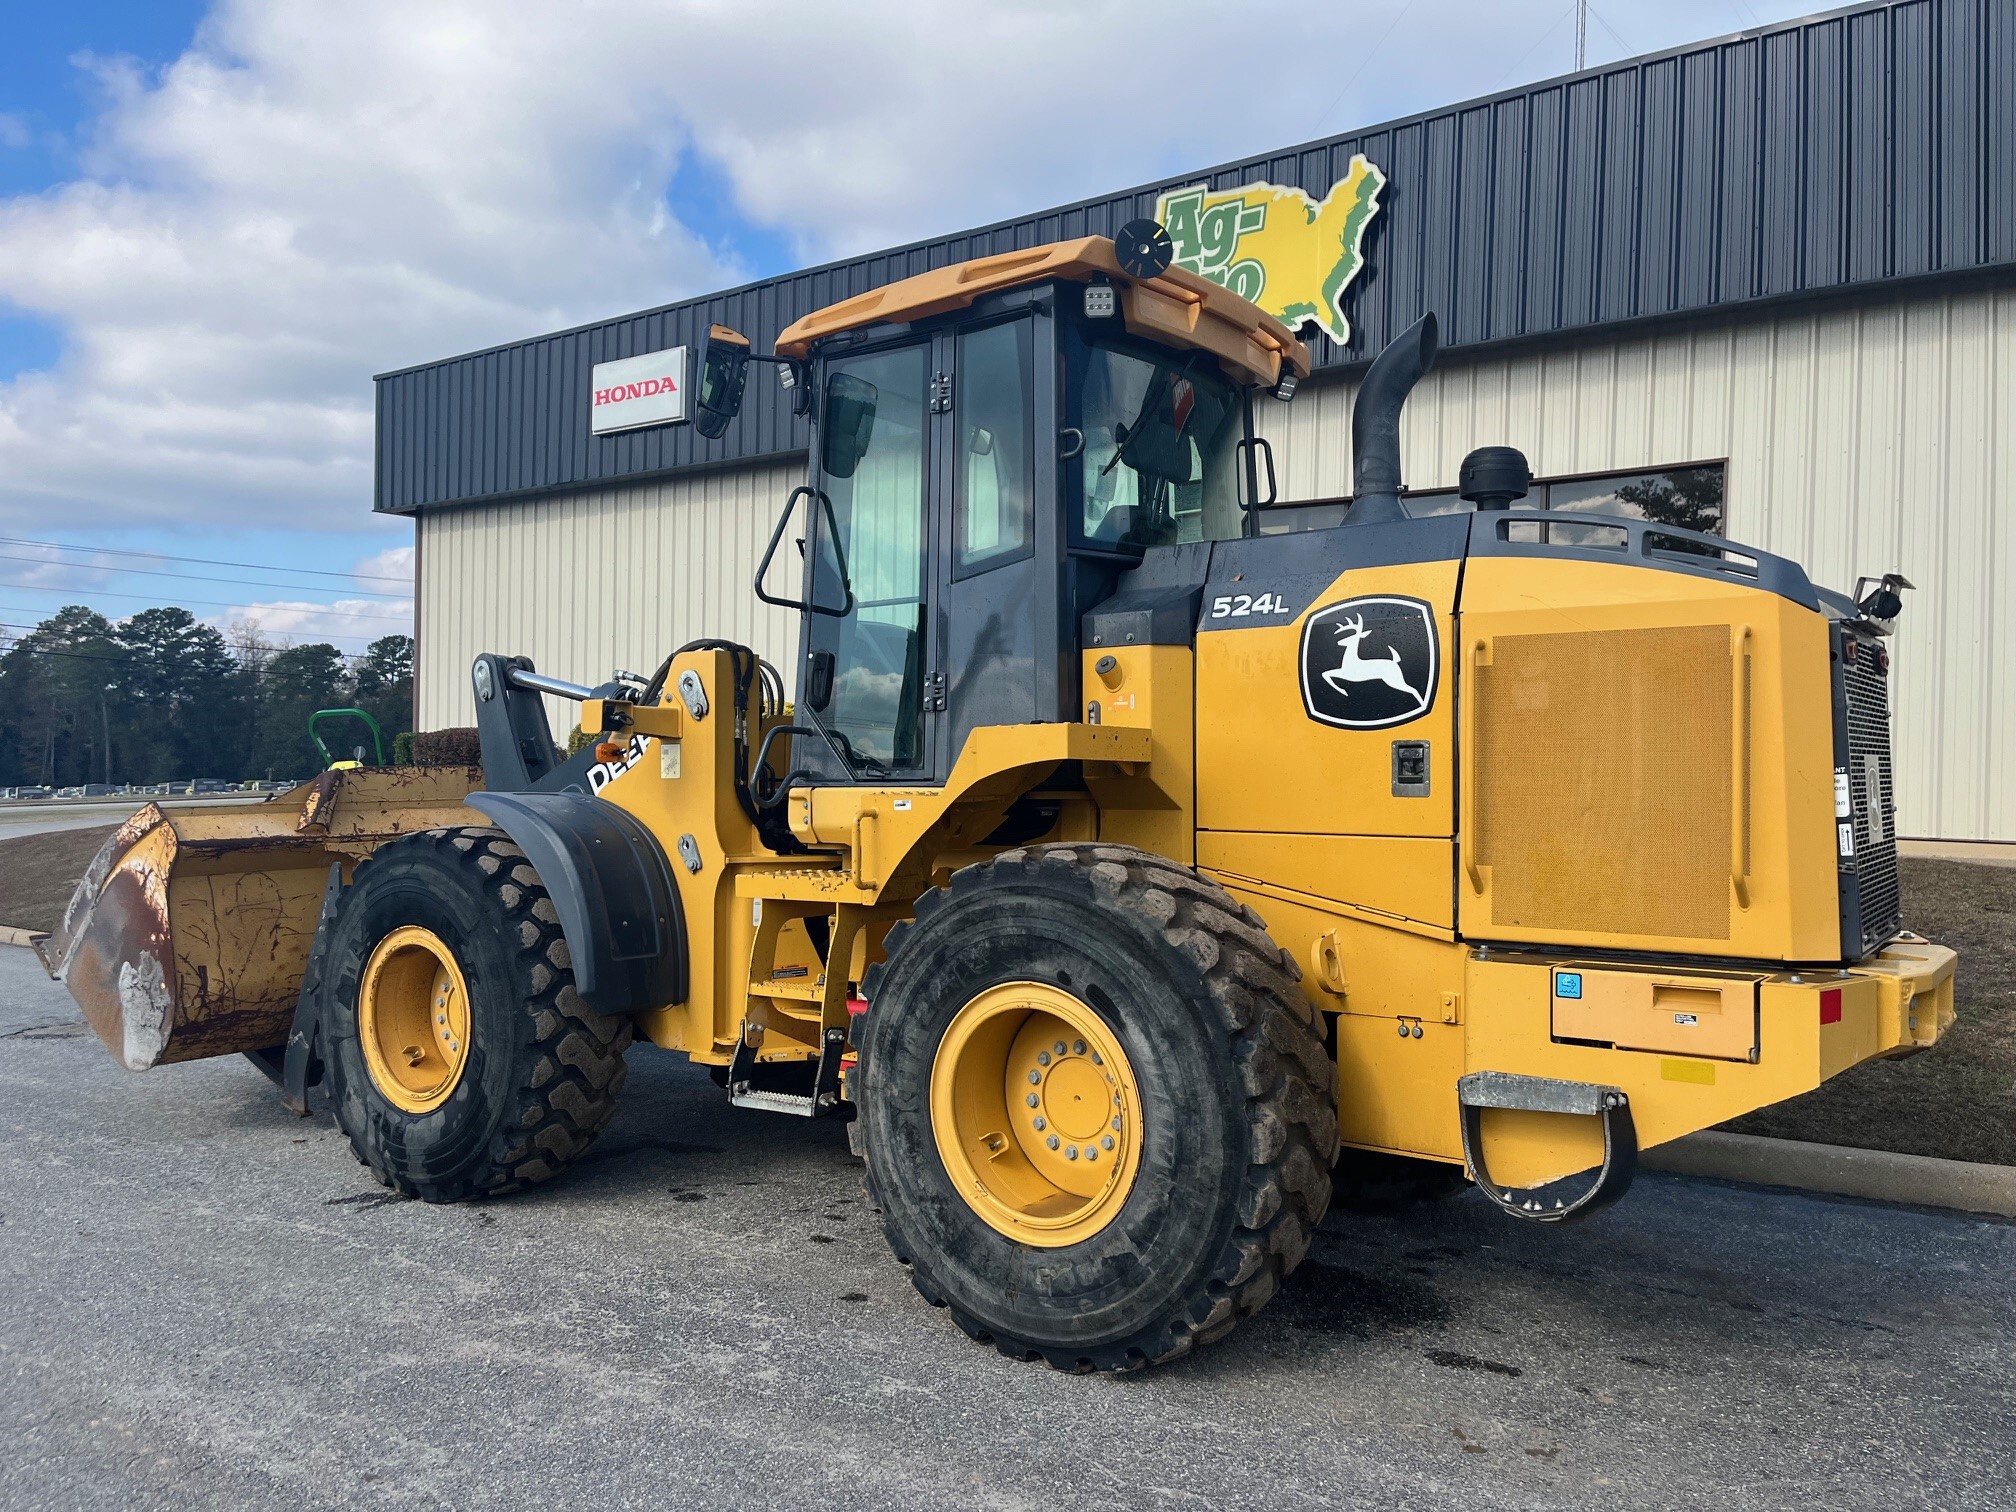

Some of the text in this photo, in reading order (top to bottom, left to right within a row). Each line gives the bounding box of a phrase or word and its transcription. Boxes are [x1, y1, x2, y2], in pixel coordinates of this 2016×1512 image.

[1166, 192, 1266, 268] Ag-
[594, 376, 678, 407] HONDA
[1211, 592, 1290, 618] 524L
